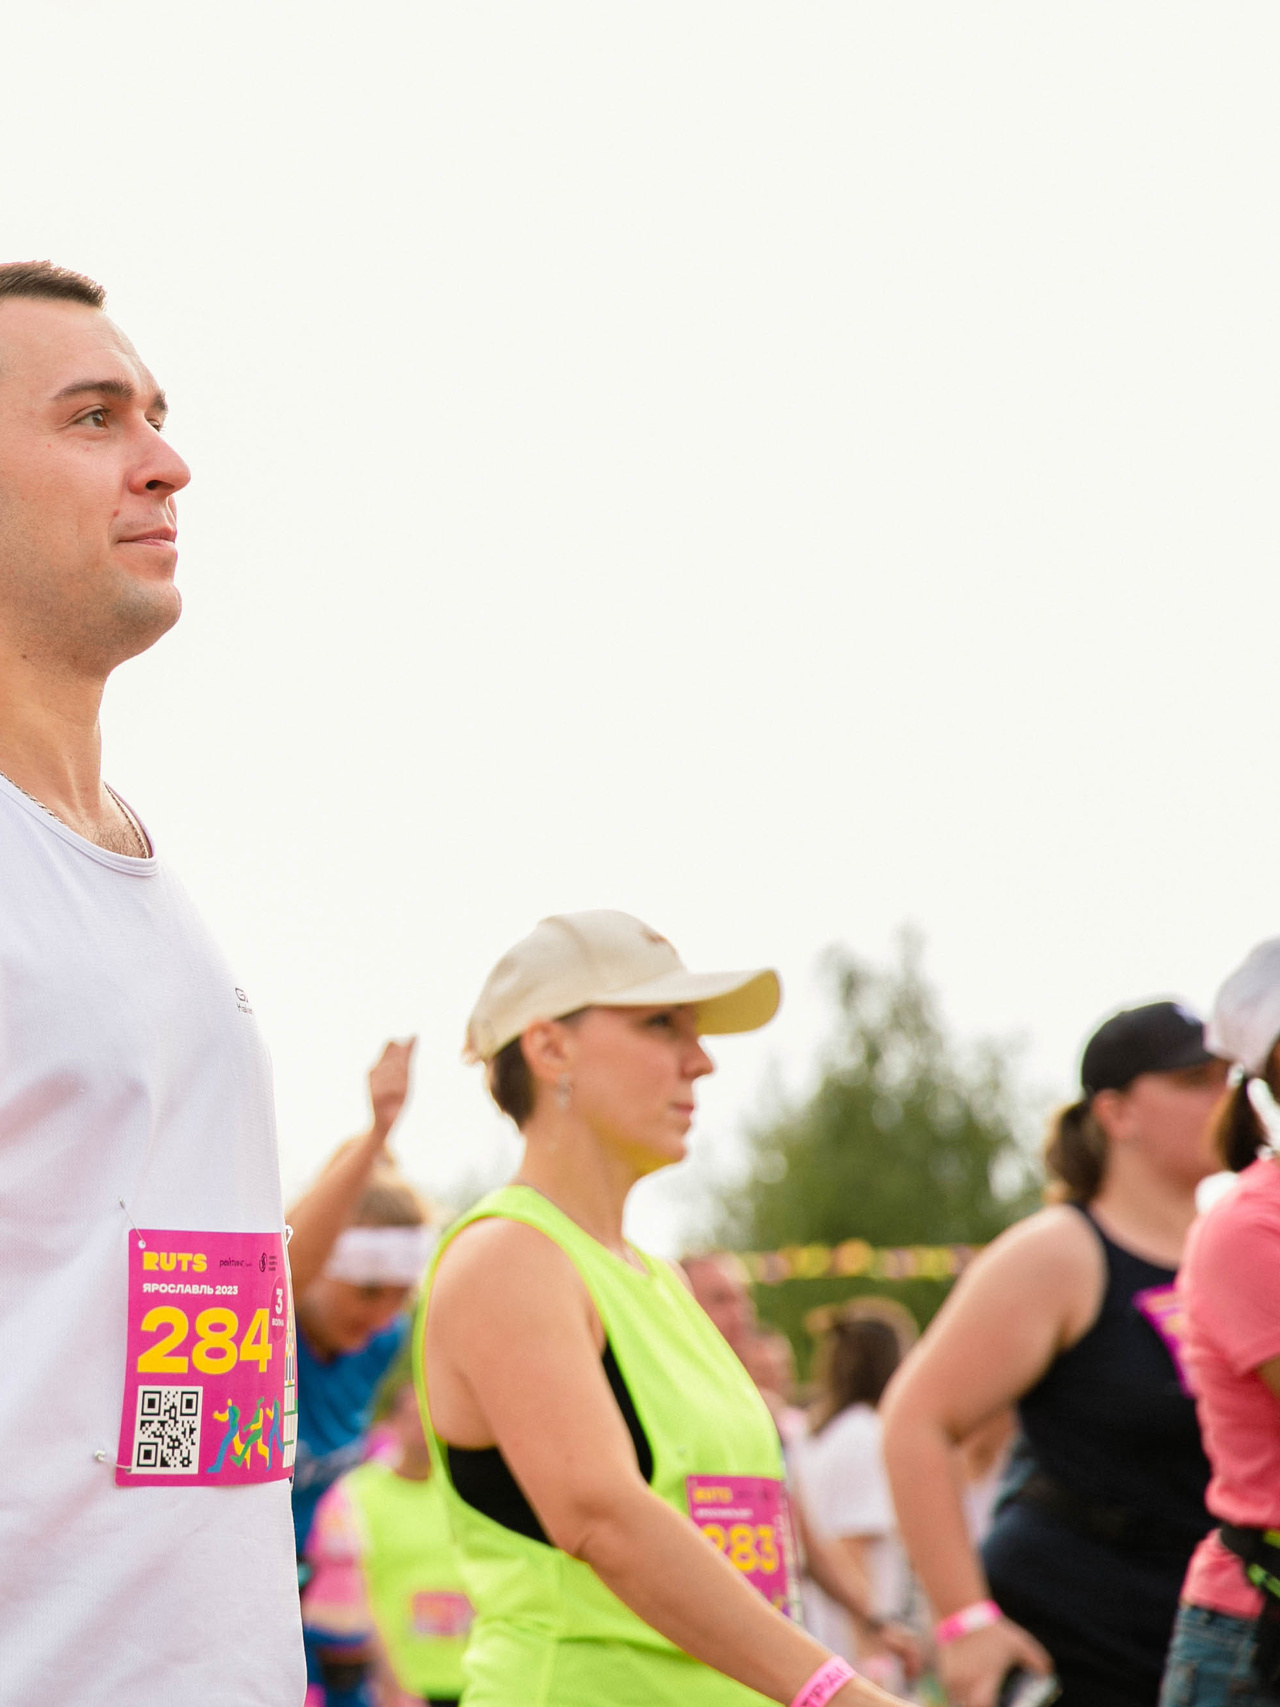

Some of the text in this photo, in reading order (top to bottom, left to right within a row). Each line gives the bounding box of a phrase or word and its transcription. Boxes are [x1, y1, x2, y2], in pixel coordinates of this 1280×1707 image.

[143, 1251, 207, 1272] RUTS
[143, 1283, 239, 1295] ЯРОСЛАВЛЬ 2023
[275, 1288, 283, 1315] 3
[137, 1305, 272, 1375] 284
